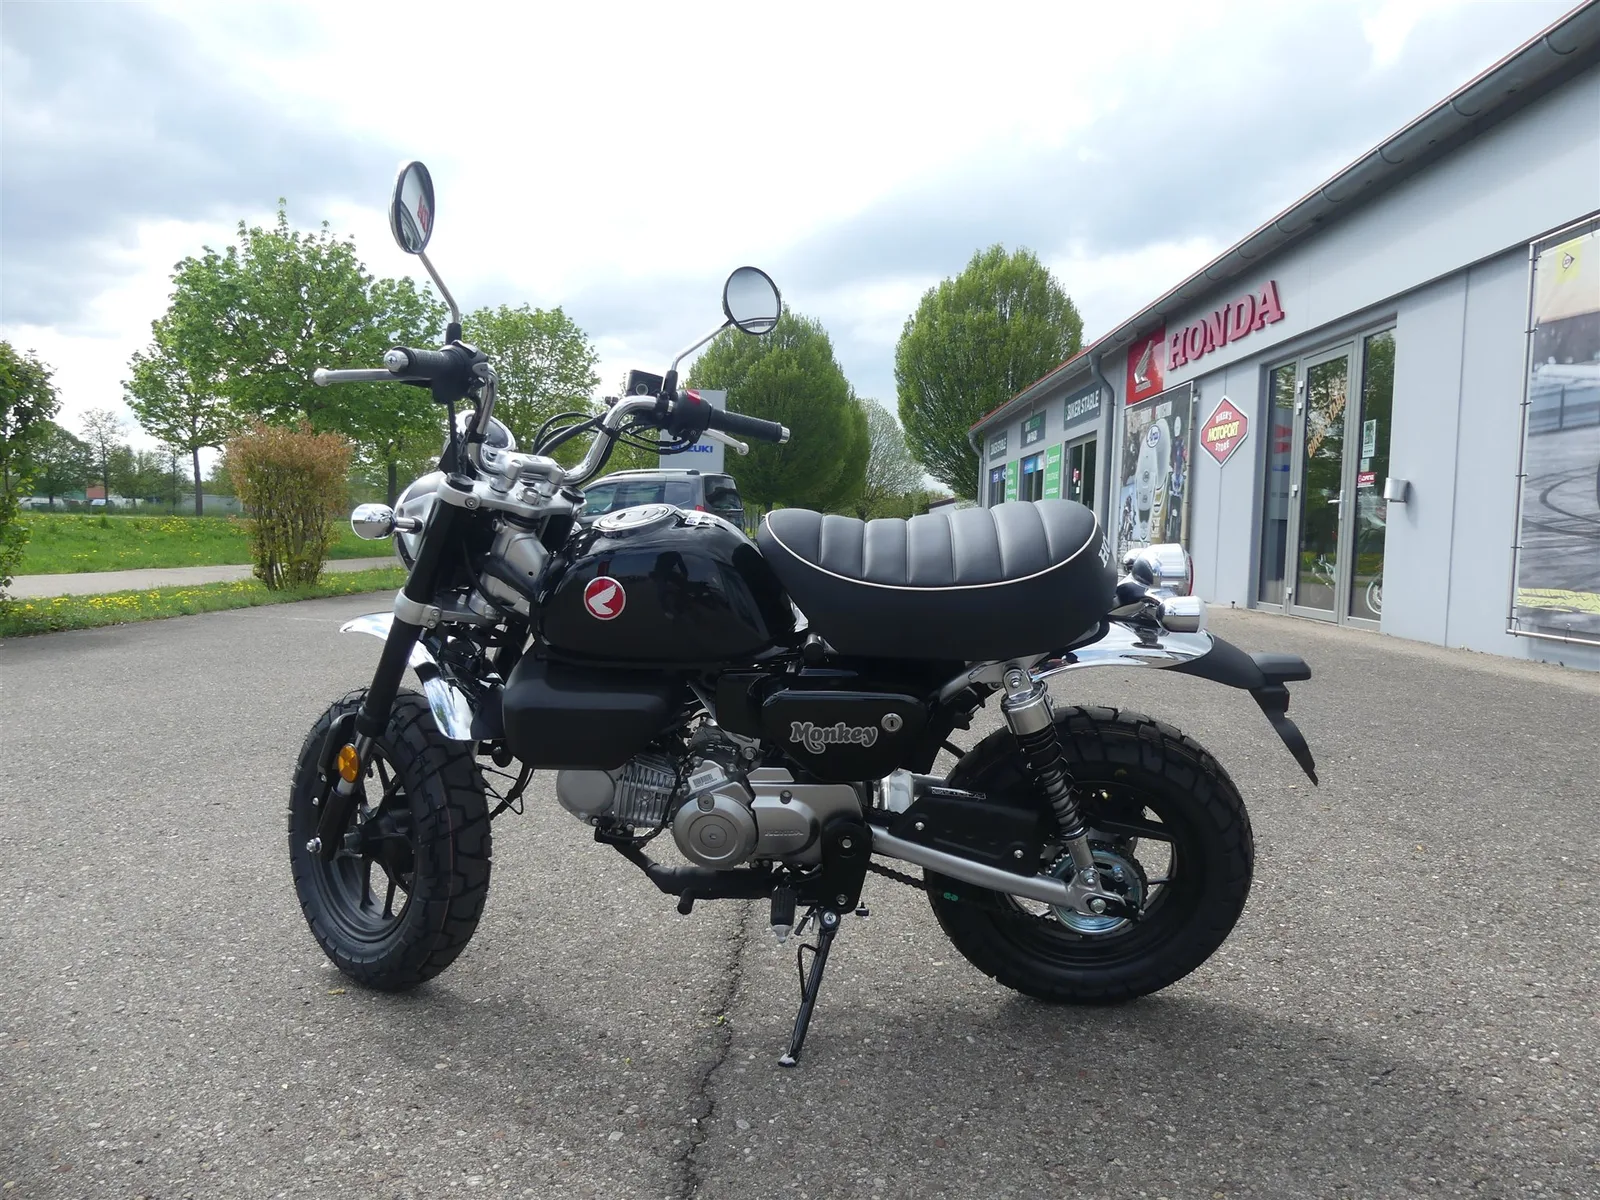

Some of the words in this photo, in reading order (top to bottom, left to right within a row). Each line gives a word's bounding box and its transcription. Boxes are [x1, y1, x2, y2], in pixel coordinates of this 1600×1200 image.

[1167, 280, 1284, 371] HONDA
[1066, 399, 1081, 420] BIKER
[1080, 390, 1099, 414] STABLE
[1215, 440, 1230, 452] STORE
[790, 721, 878, 754] Monkey
